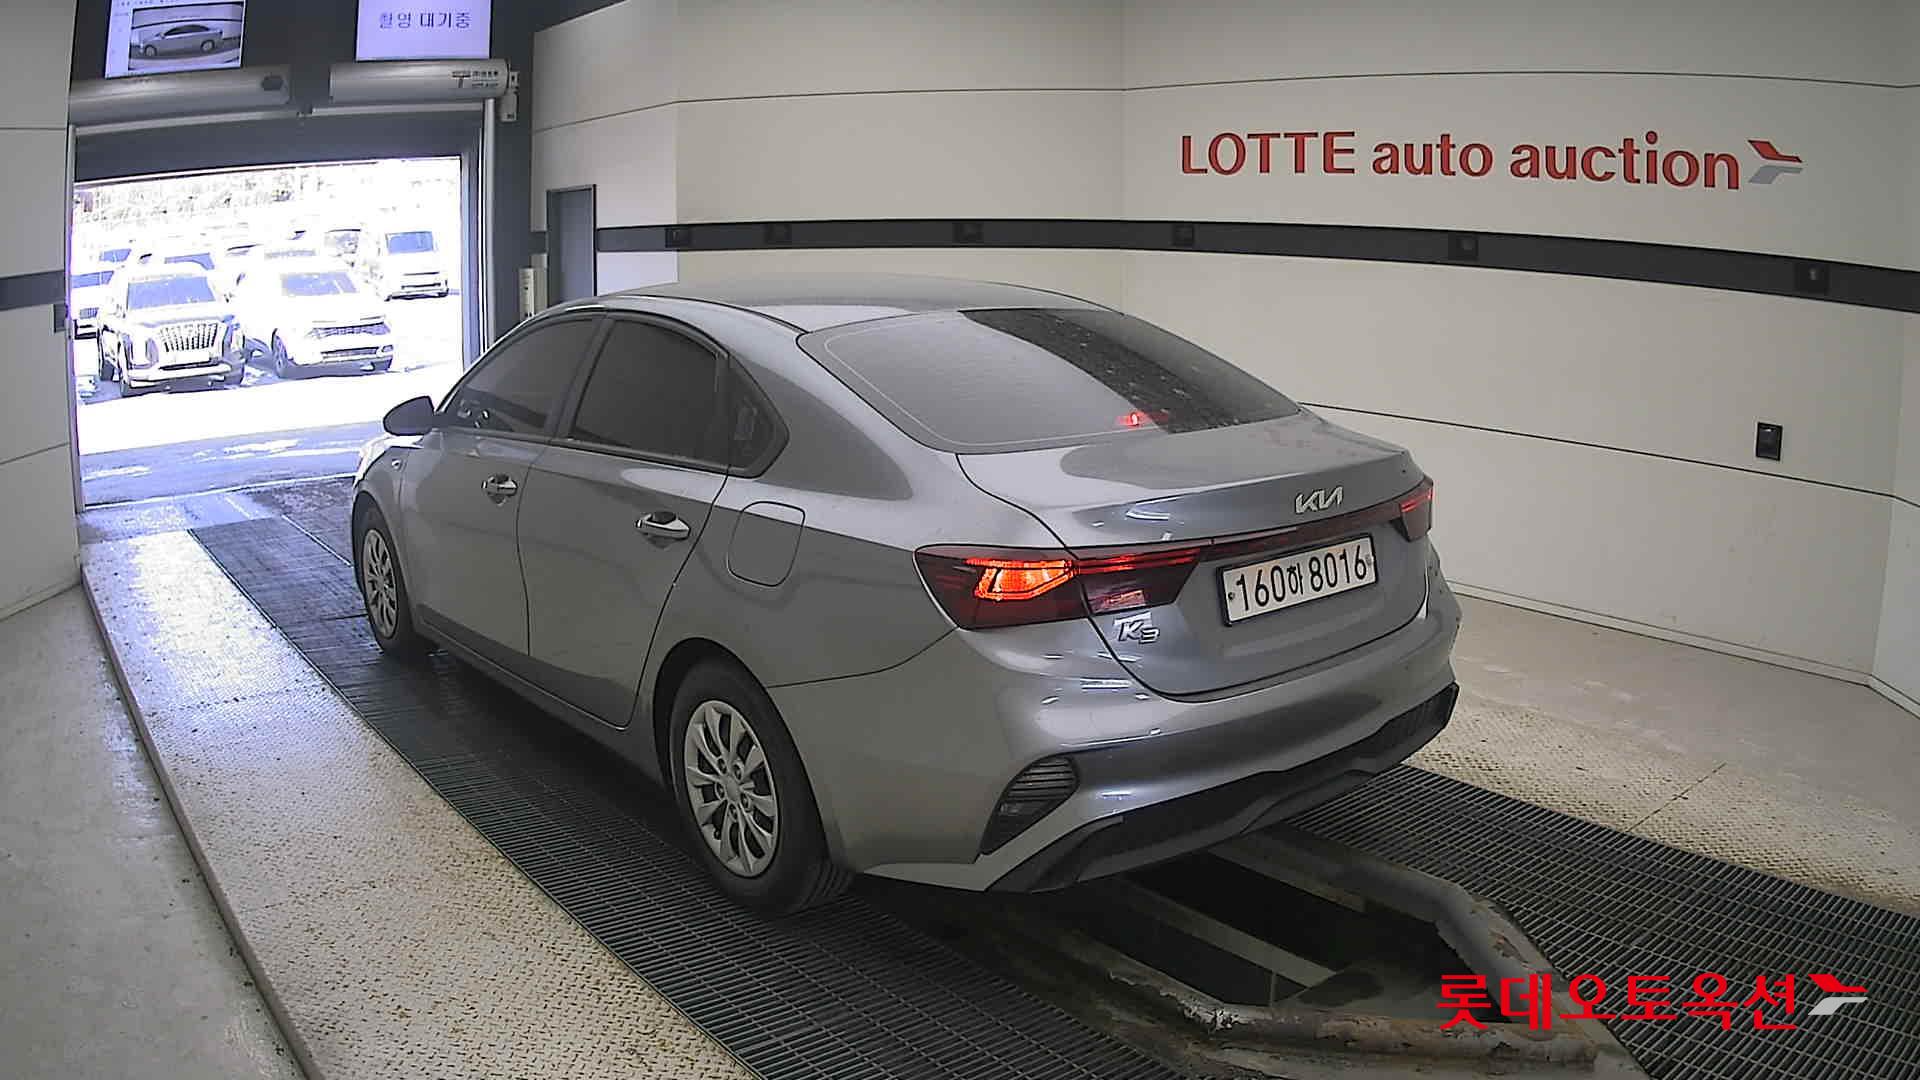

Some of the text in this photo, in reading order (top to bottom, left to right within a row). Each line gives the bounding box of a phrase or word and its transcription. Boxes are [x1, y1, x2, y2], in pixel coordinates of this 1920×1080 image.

[420, 12, 472, 29] 대기중
[1182, 130, 1741, 190] LOTTE auto auction
[1308, 545, 1367, 592] 8016
[1118, 619, 1160, 644] K3
